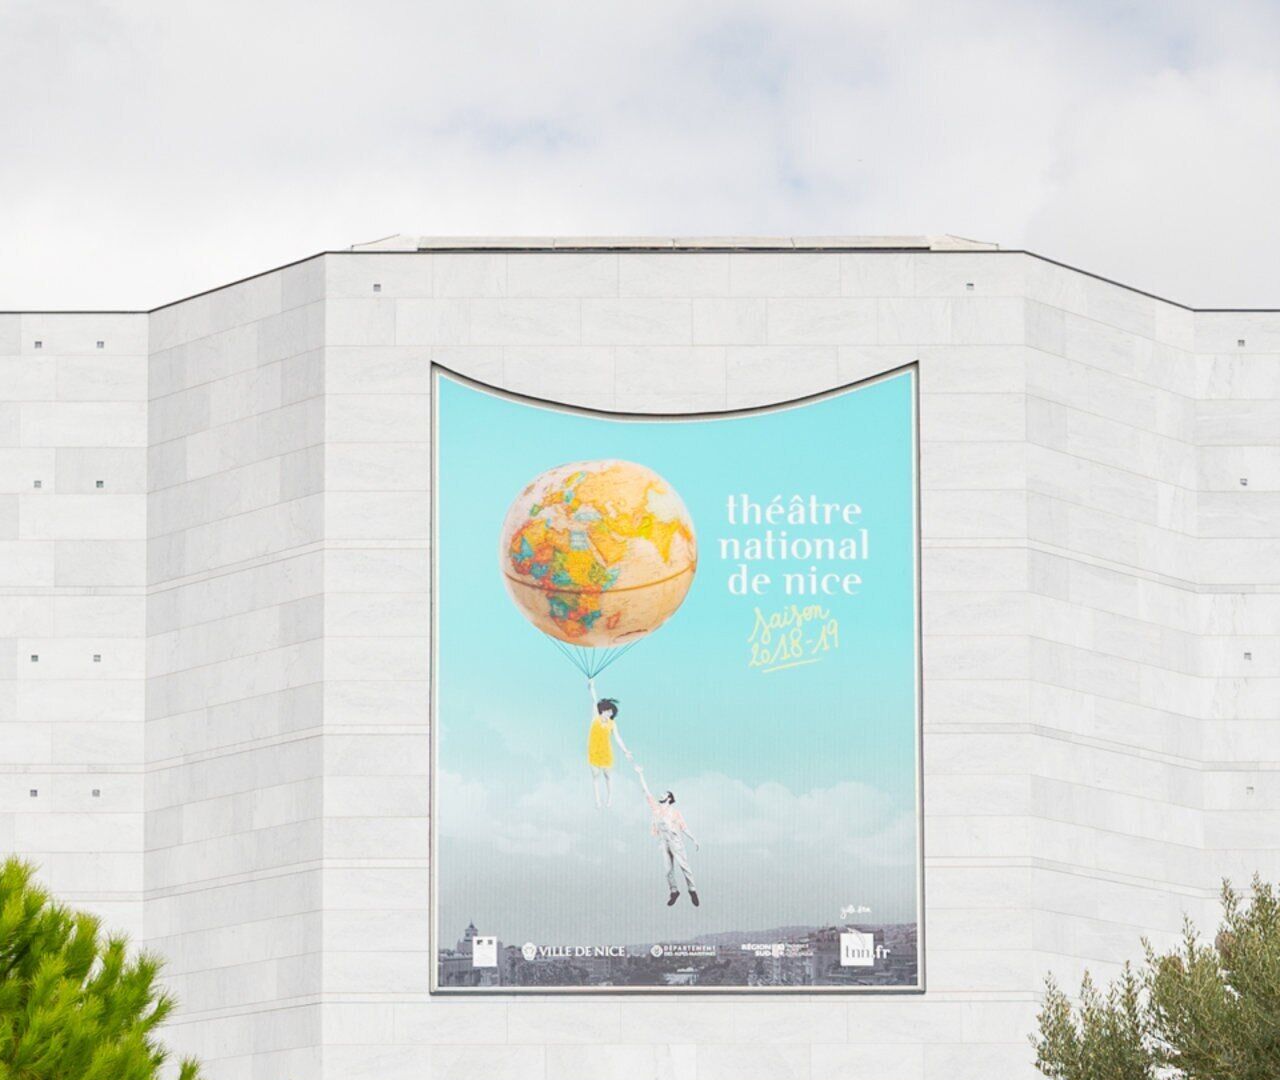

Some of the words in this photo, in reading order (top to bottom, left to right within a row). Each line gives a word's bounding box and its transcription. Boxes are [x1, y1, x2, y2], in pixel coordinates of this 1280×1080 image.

[726, 494, 862, 525] théâtre
[718, 529, 869, 560] national
[728, 564, 771, 595] de
[783, 565, 862, 595] nice
[539, 945, 571, 957] VILLE
[575, 945, 593, 957] DE
[595, 945, 625, 957] NICE
